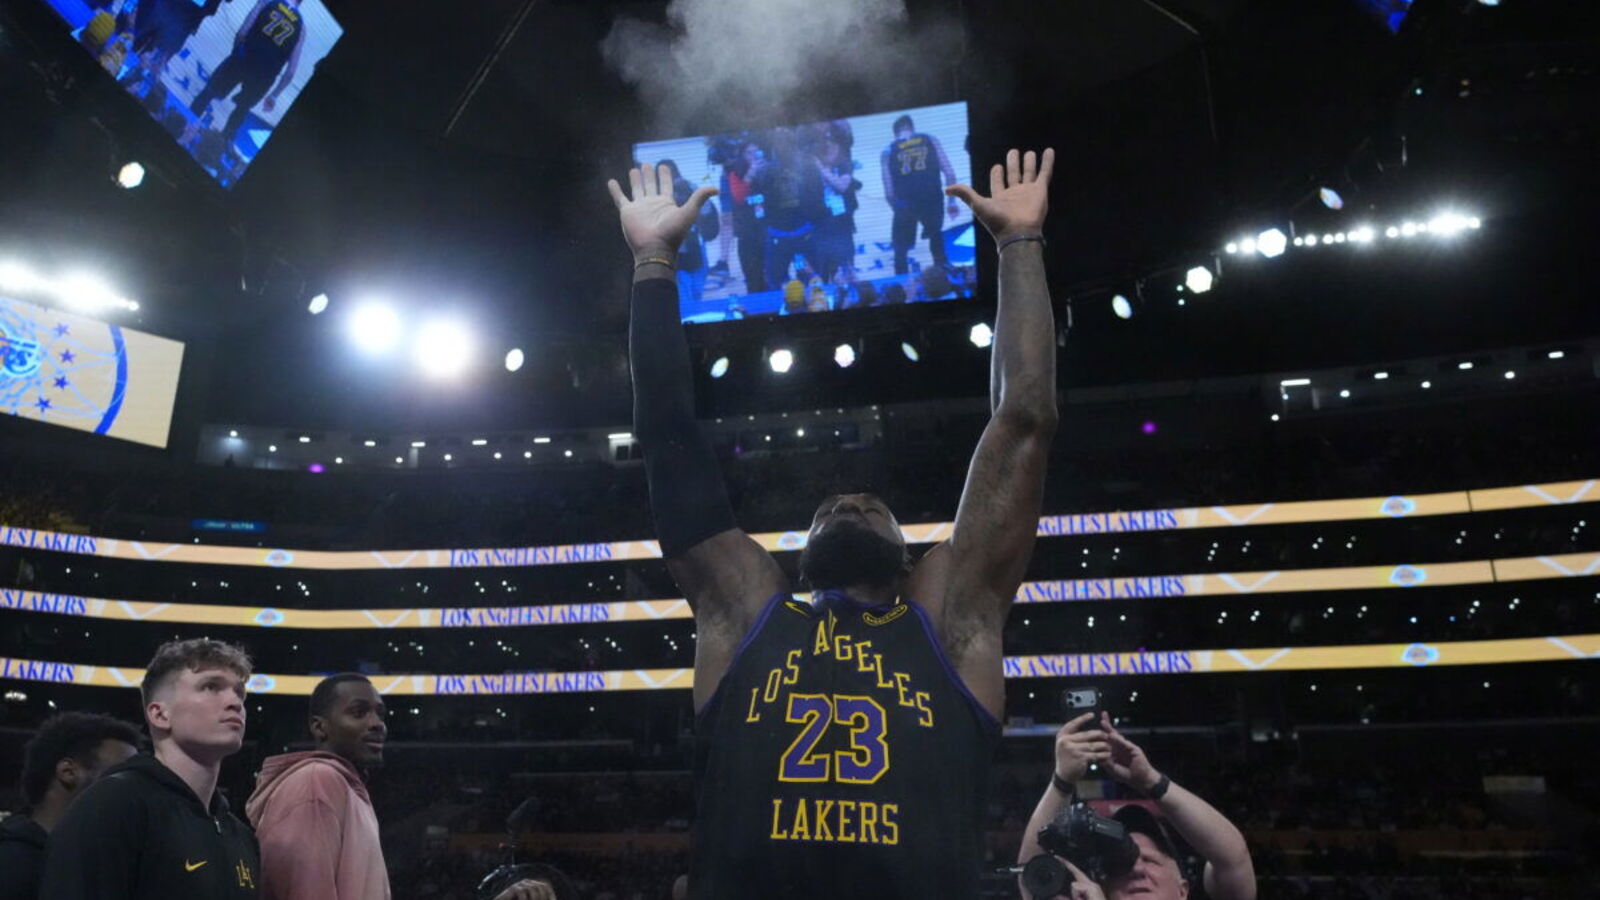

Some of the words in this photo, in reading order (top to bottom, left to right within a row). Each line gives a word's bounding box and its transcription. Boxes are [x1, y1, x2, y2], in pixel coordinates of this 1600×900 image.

[262, 10, 295, 47] 77
[1104, 510, 1178, 533] LAKERS
[30, 529, 98, 554] LAKERS
[450, 549, 480, 567] LOS
[484, 546, 550, 567] ANGELES
[552, 543, 612, 563] LAKERS
[1022, 578, 1107, 602] ANGELES
[1109, 575, 1186, 599] LAKERS
[17, 590, 87, 616] LAKERS
[440, 608, 472, 627] LOS
[478, 605, 545, 627] ANGELES
[548, 603, 609, 624] LAKERS
[3, 657, 75, 683] LAKERS
[1026, 653, 1112, 677] ANGELES
[1114, 651, 1193, 675] LAKERS
[435, 674, 466, 694] LOS
[470, 672, 540, 694] ANGELES
[542, 671, 605, 693] LAKERS
[746, 649, 802, 723] LOS
[778, 693, 890, 784] 23
[770, 798, 899, 845] LAKERS
